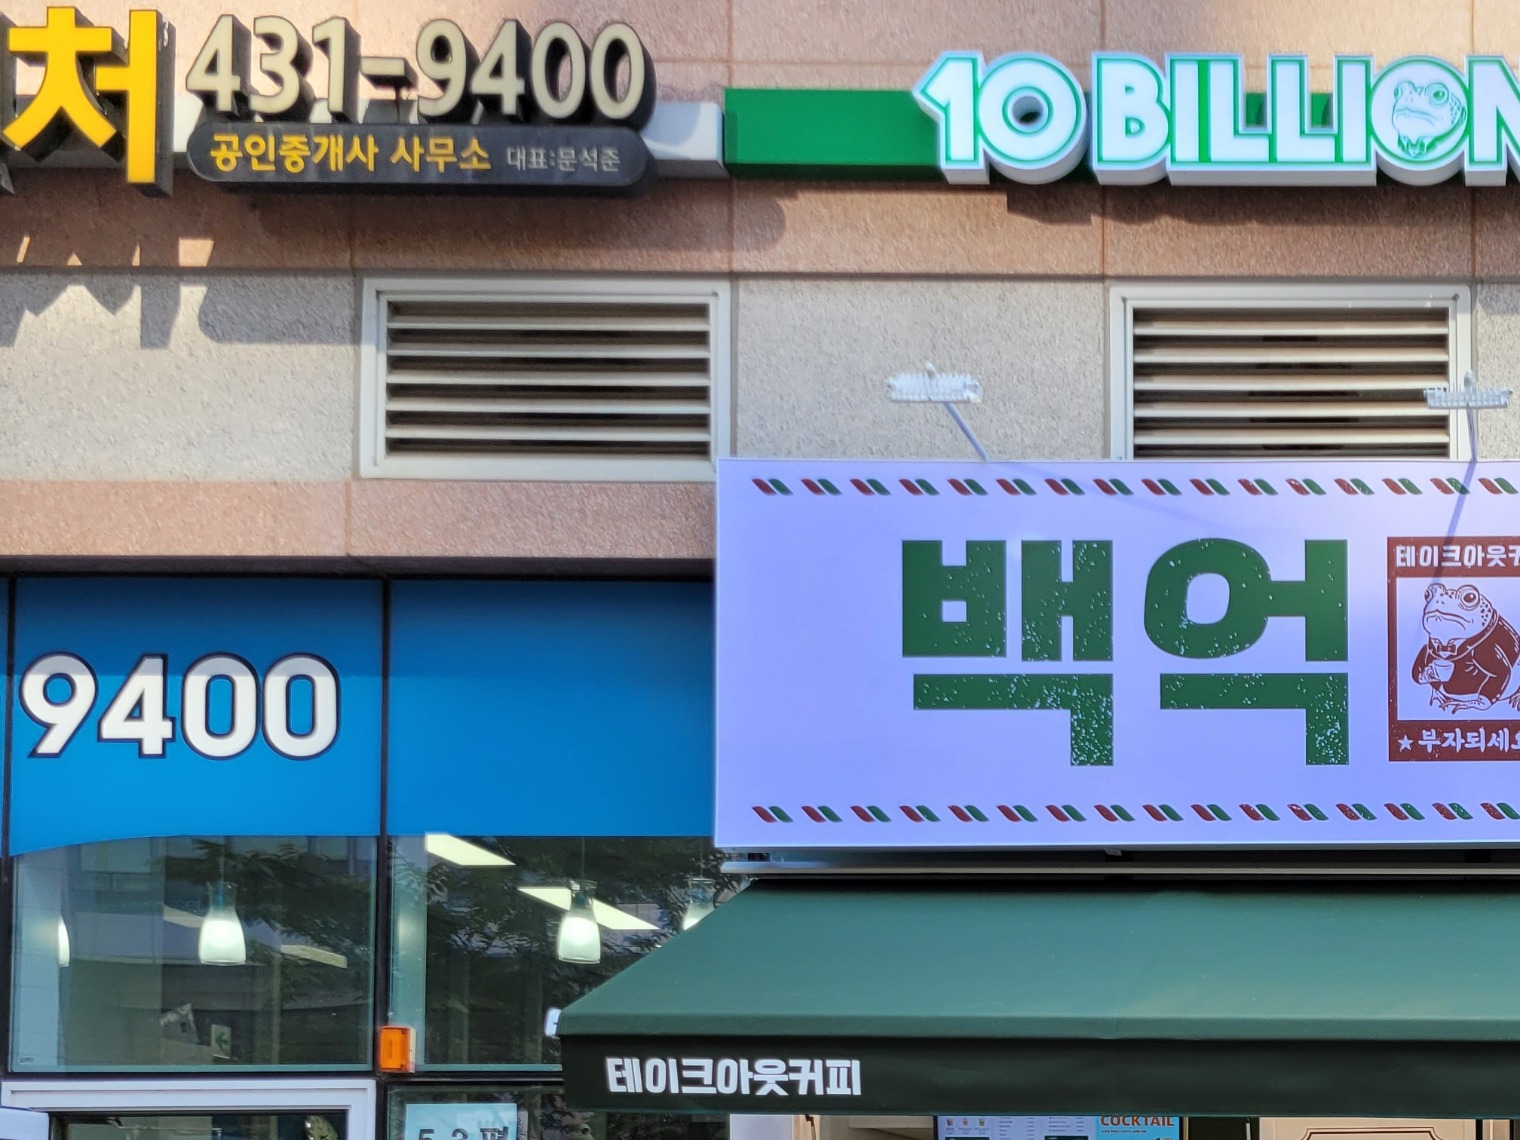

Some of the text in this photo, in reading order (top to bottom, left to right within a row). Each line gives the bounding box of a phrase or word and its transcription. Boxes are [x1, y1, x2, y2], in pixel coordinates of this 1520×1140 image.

[186, 14, 648, 120] 431-9400
[913, 50, 1086, 172] 10
[210, 133, 379, 174] 공인중개사
[391, 136, 491, 173] 사무소
[901, 537, 1350, 767] 백억
[19, 651, 340, 761] 9400
[606, 1057, 862, 1096] 테이크아웃커피
[1101, 1115, 1175, 1126] COCKTAIL
